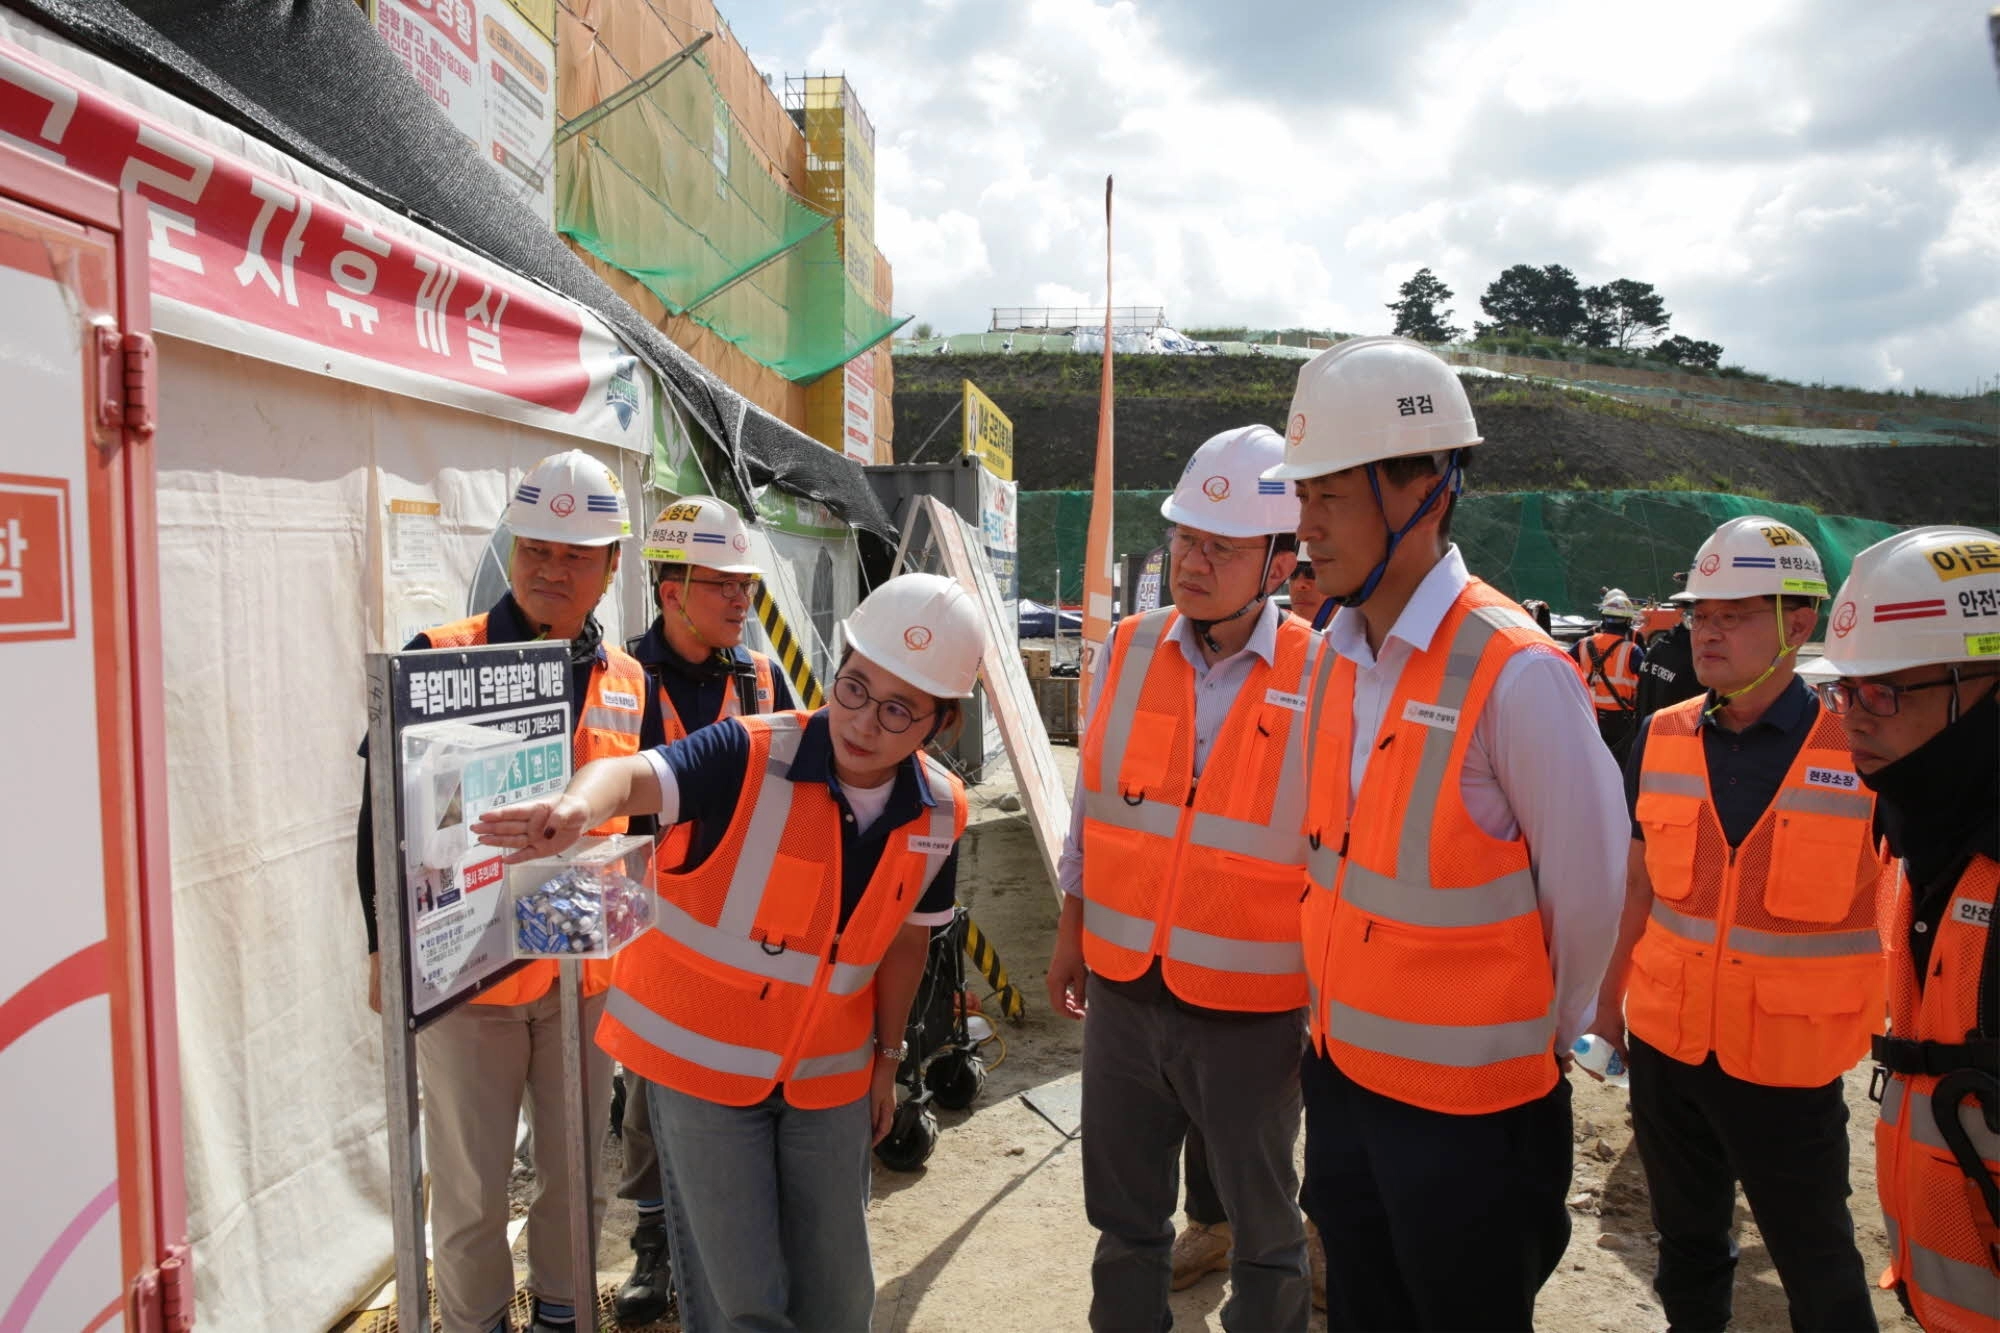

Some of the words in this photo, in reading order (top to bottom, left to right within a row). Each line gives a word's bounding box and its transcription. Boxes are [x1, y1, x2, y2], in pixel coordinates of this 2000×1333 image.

[1397, 394, 1434, 417] 점검
[1932, 544, 2000, 572] 이문
[1958, 588, 2000, 618] 안전
[409, 668, 476, 715] 폭염대비
[479, 662, 536, 707] 온열질환
[538, 660, 565, 697] 예방
[531, 713, 561, 734] 기본수칙
[1809, 768, 1854, 787] 현장소장
